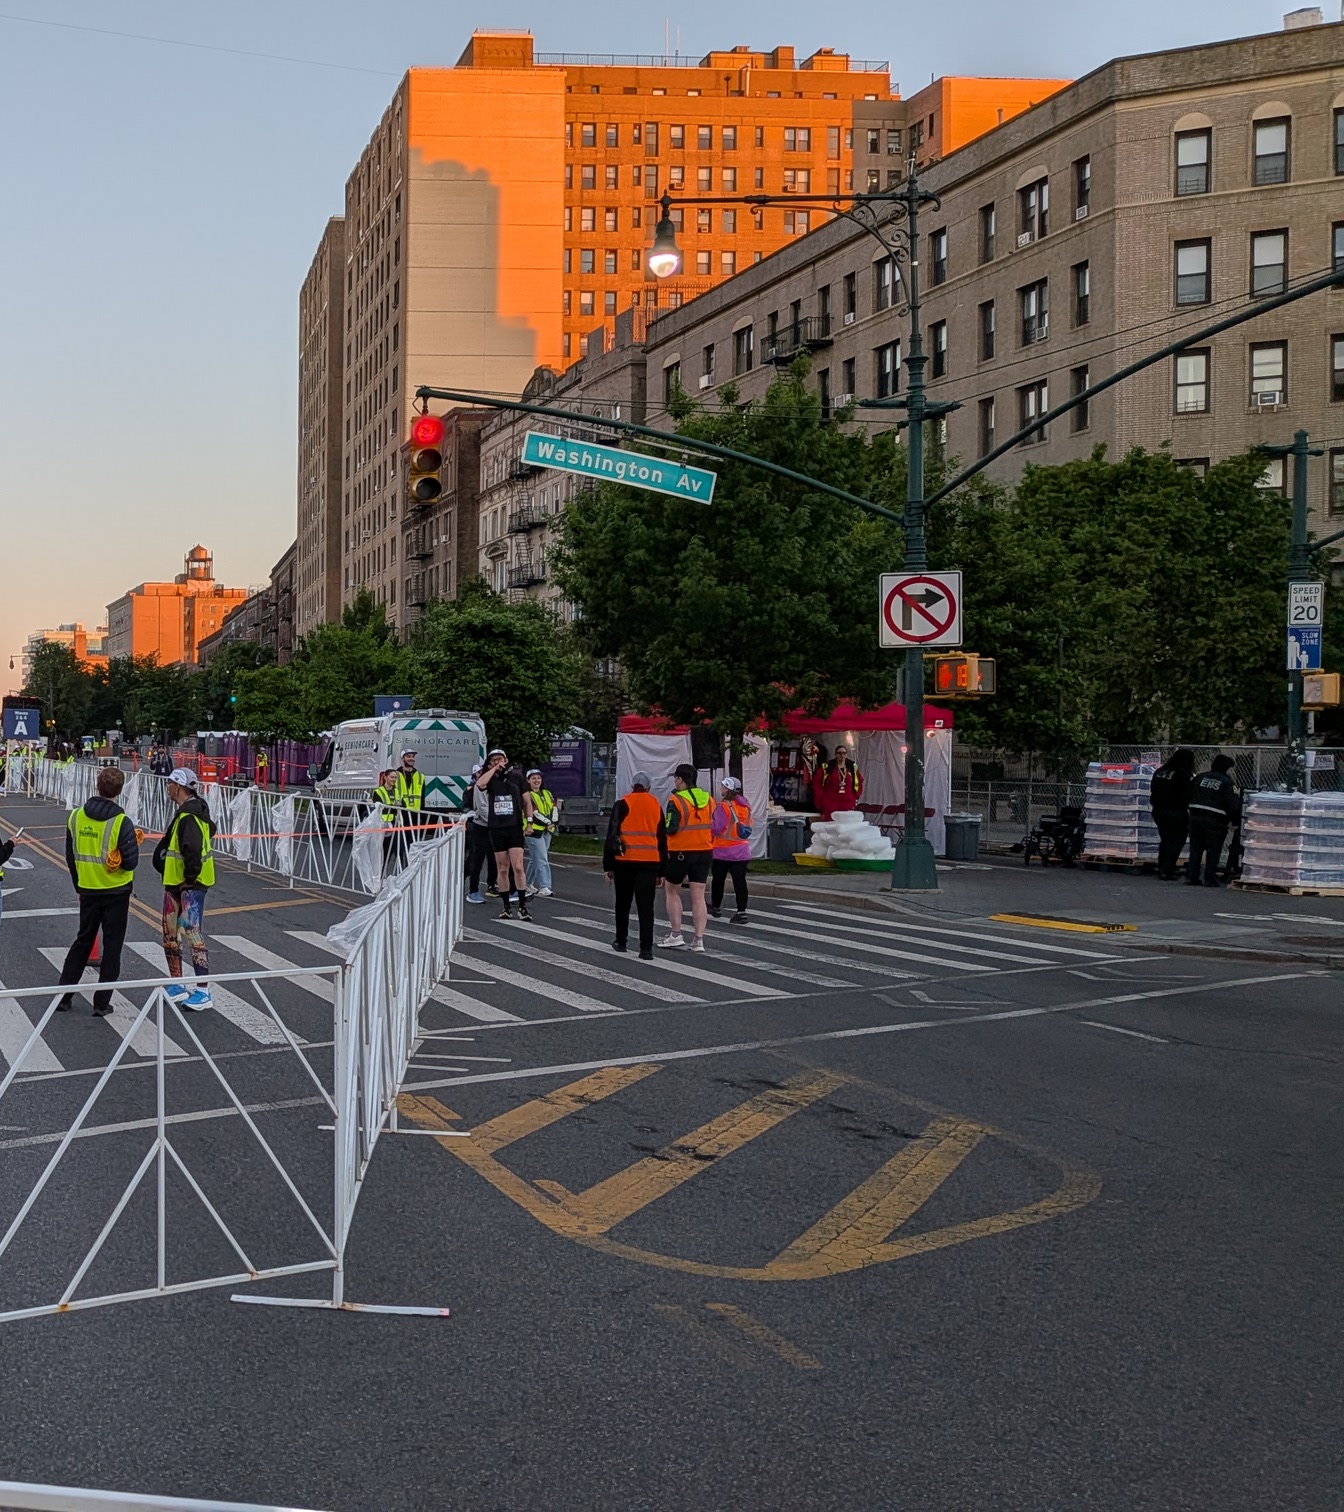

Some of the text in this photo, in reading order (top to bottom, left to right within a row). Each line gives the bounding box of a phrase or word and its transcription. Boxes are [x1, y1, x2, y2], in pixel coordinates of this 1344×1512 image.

[538, 441, 702, 492] Washington Av
[1293, 605, 1318, 621] 20
[14, 721, 28, 735] A
[345, 740, 375, 750] SENIORCARE
[396, 738, 478, 746] SENIORCARE
